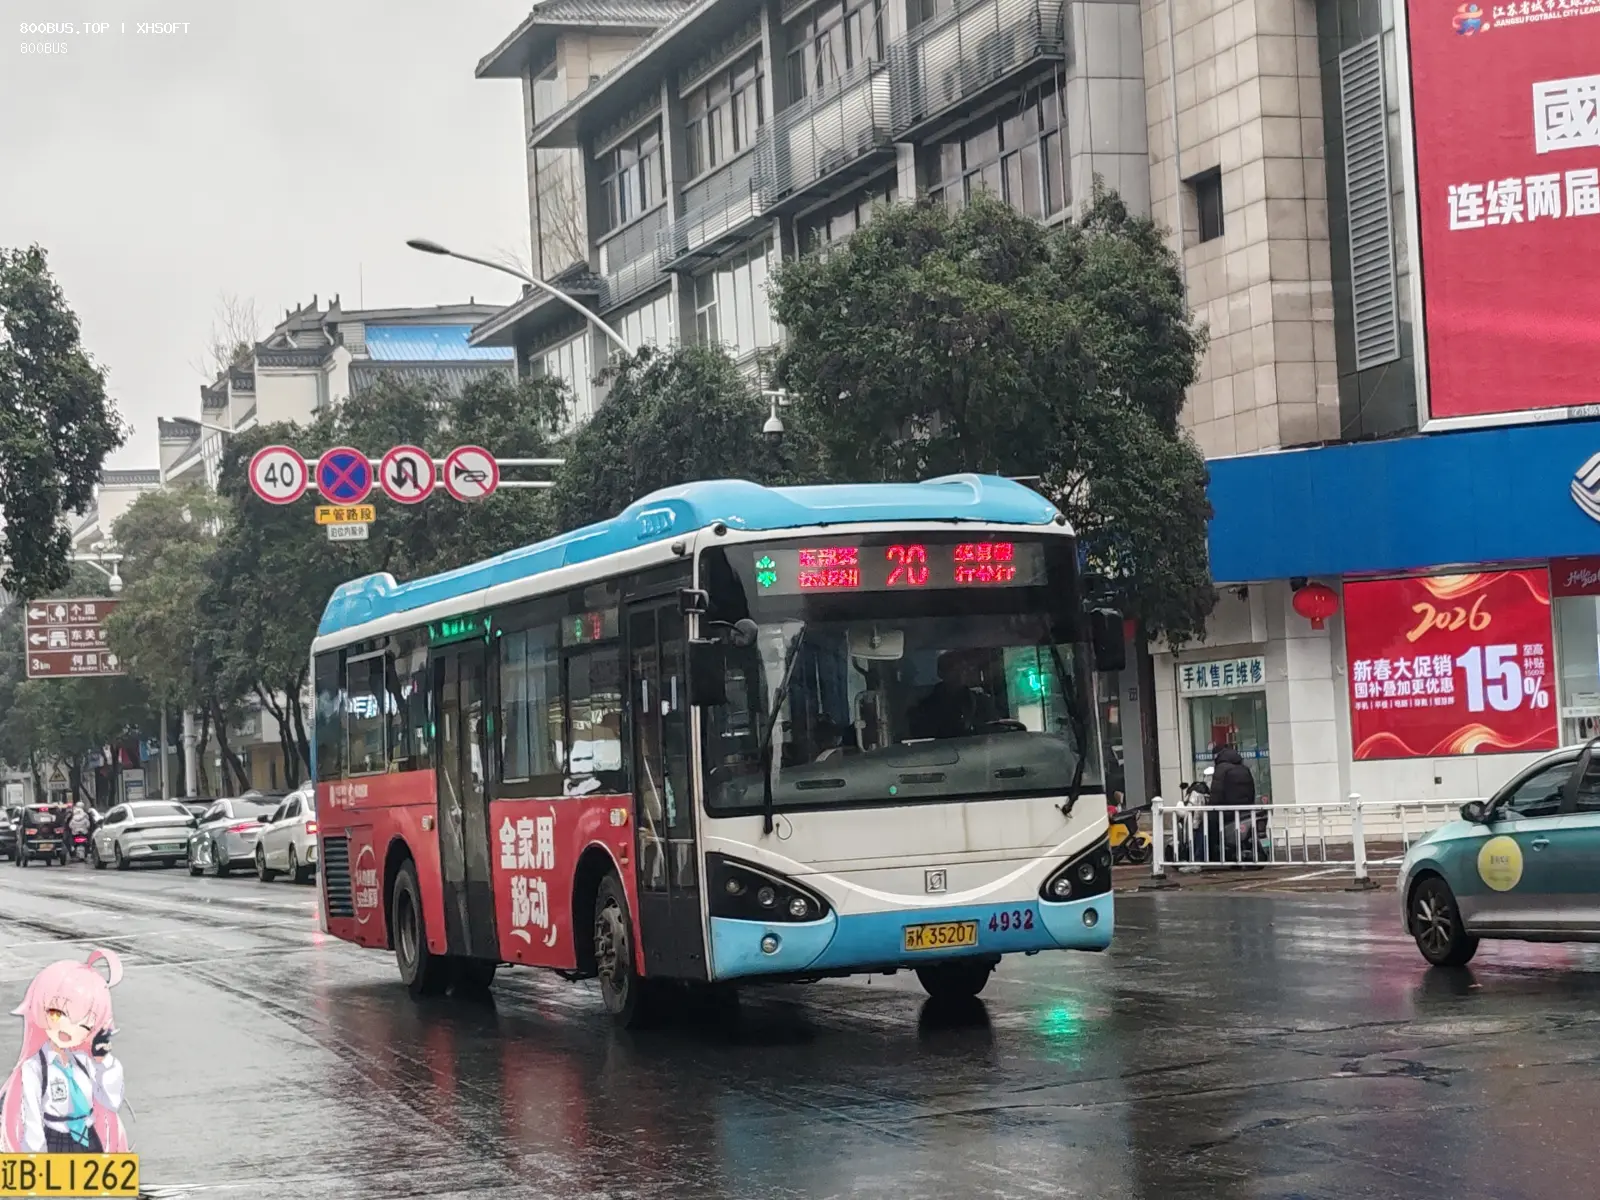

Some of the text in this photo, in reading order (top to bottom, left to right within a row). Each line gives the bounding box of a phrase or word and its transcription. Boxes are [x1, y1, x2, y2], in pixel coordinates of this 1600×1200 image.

[1492, 0, 1600, 19] 江苏省城市足球
[1494, 16, 1525, 27] JIANGSU
[1526, 12, 1562, 23] FOOTBALL
[1563, 8, 1579, 17] CITY
[1448, 168, 1600, 231] 连续两届
[264, 462, 294, 487] 40
[319, 507, 372, 521] 严管路段
[887, 544, 929, 586] 20
[70, 604, 96, 615] 个园
[1406, 594, 1492, 642] 2026
[1183, 659, 1263, 689] 手机售后维修
[1353, 655, 1452, 681] 新春大促销
[1524, 657, 1545, 669] 补贴
[1354, 677, 1453, 699] 国补叠加更优惠
[499, 815, 555, 869] 全家用
[511, 876, 549, 929] 移动
[989, 908, 1034, 932] 4932
